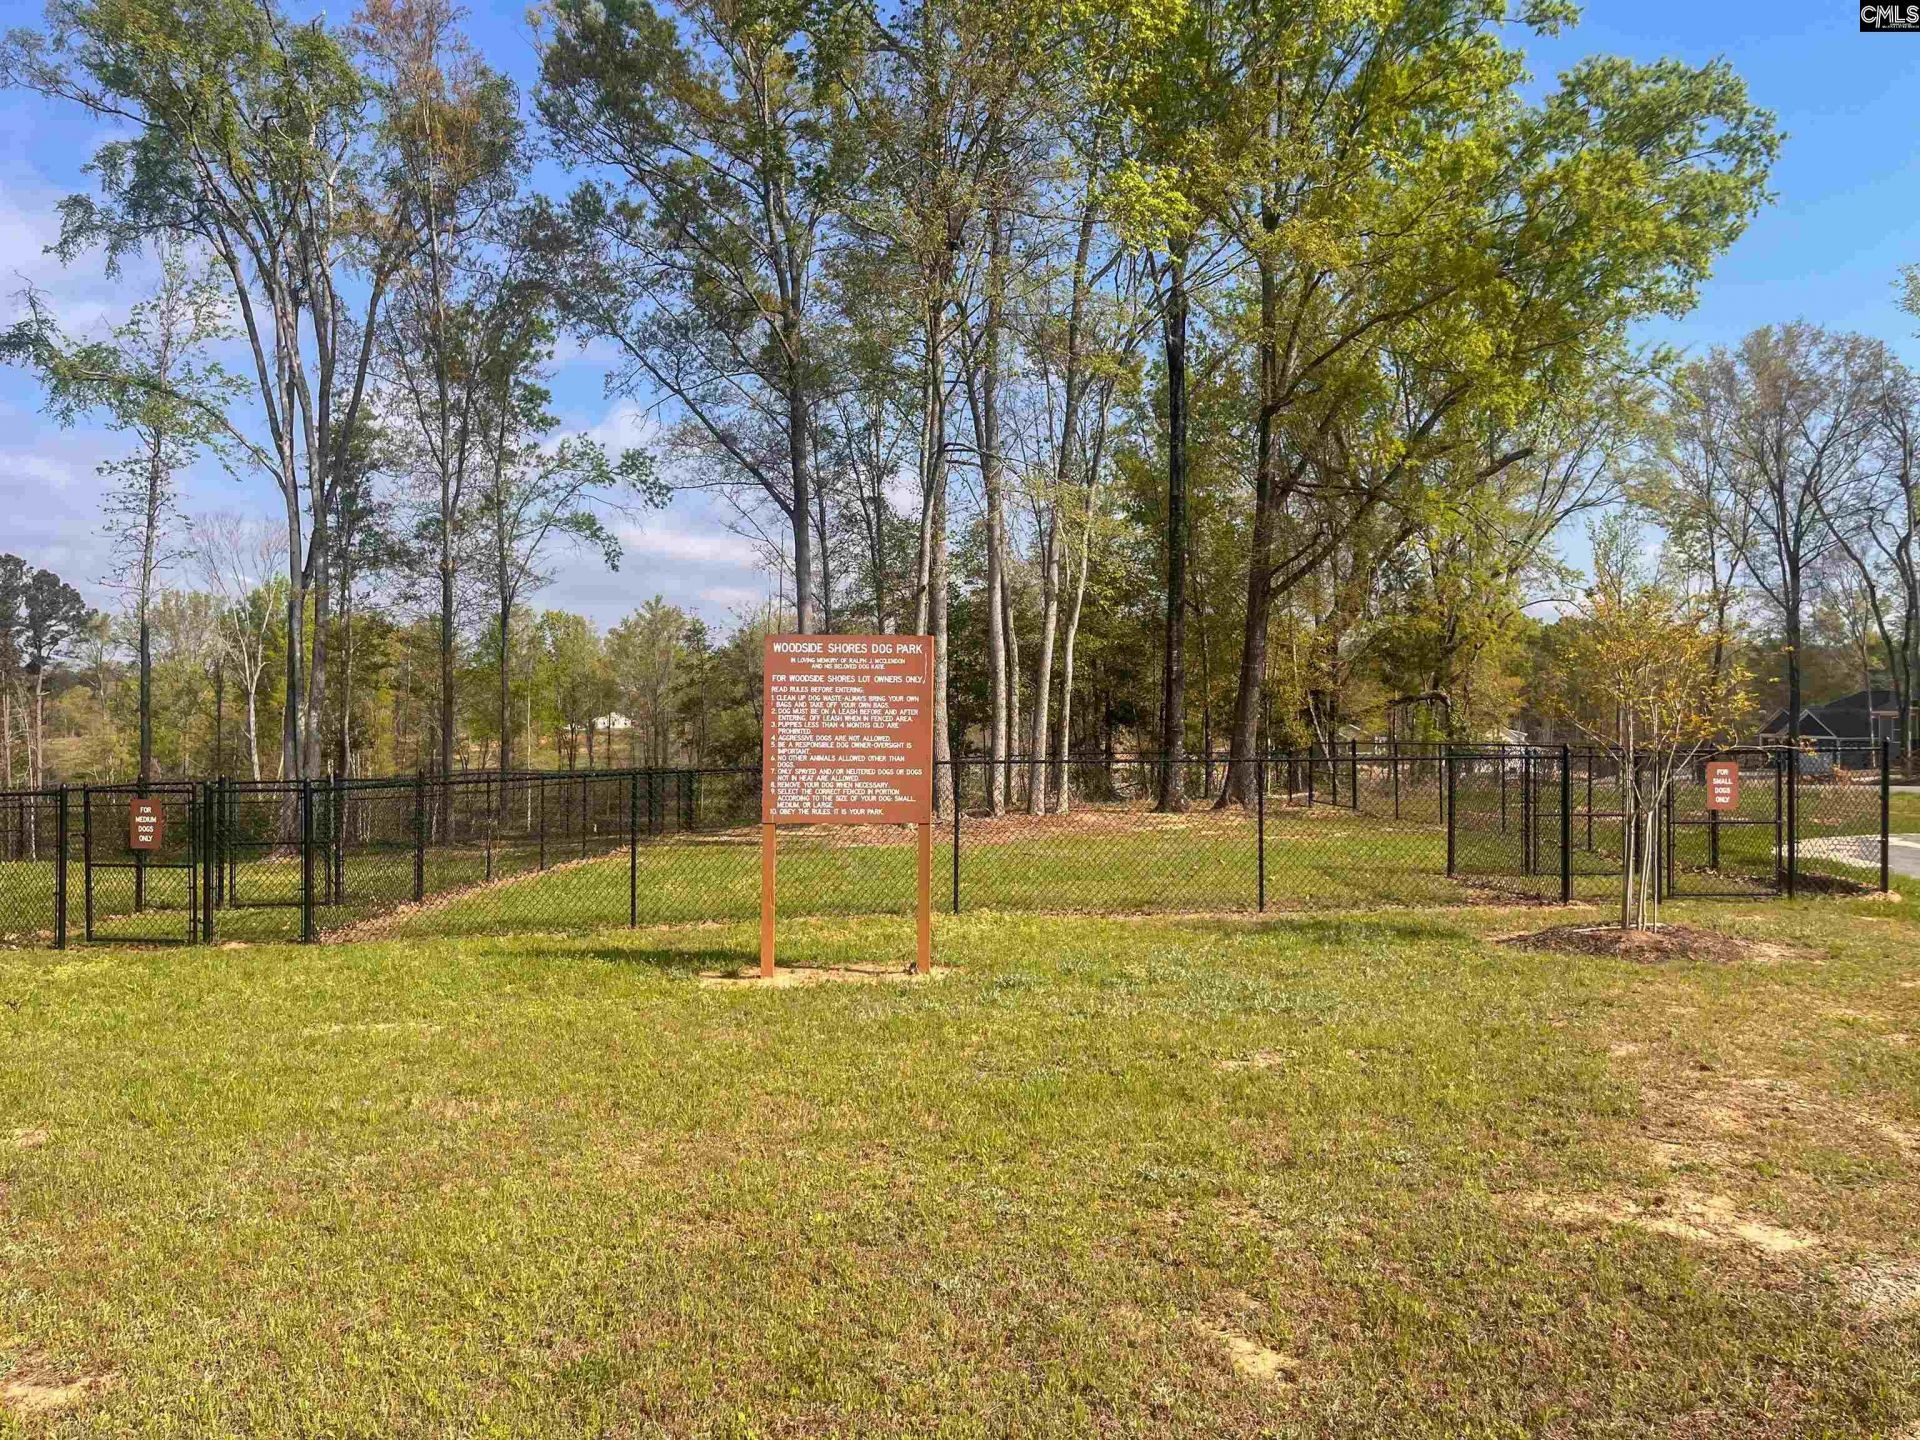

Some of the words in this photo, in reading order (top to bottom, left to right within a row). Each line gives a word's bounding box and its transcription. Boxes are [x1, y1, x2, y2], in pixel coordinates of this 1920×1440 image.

[773, 642, 823, 653] WOODSIDE
[828, 643, 867, 653] SHORES
[872, 643, 892, 654] DOG
[897, 643, 922, 654] PARK
[827, 675, 855, 683] SHORES
[858, 675, 871, 683] LOT
